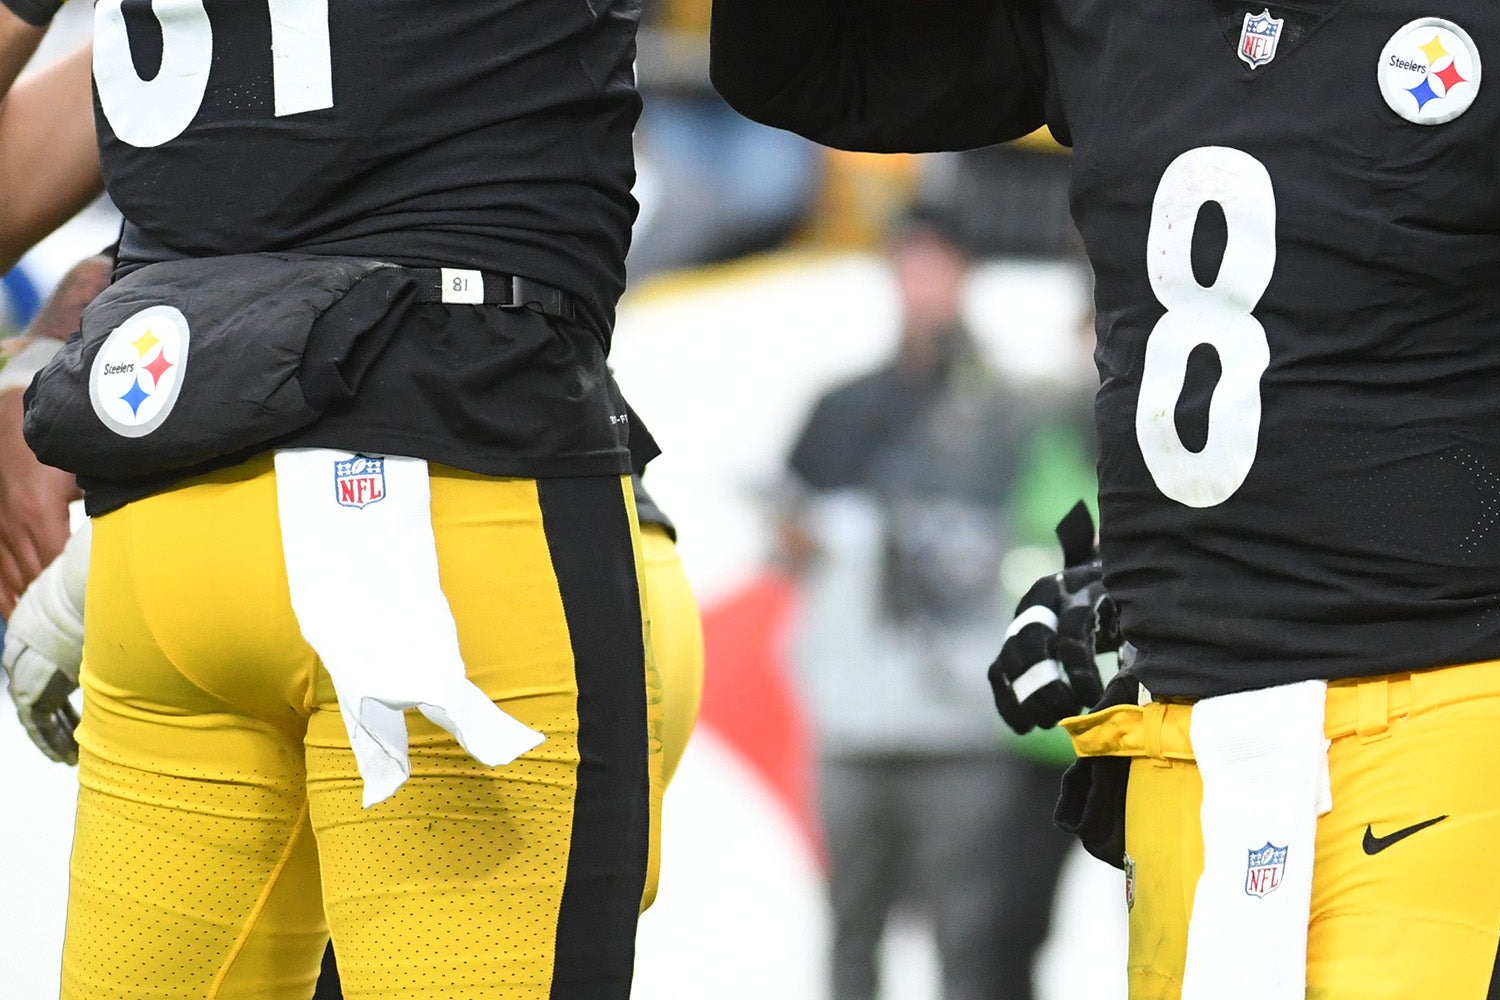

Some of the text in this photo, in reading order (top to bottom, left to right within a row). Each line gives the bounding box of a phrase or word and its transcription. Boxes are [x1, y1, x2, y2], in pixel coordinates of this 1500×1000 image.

[1243, 35, 1269, 60] NFL
[1389, 55, 1427, 75] Steelers
[453, 277, 469, 292] 81
[1135, 145, 1277, 509] 8
[103, 361, 135, 376] Steelers
[340, 477, 382, 504] NFL
[1249, 866, 1279, 893] NFL
